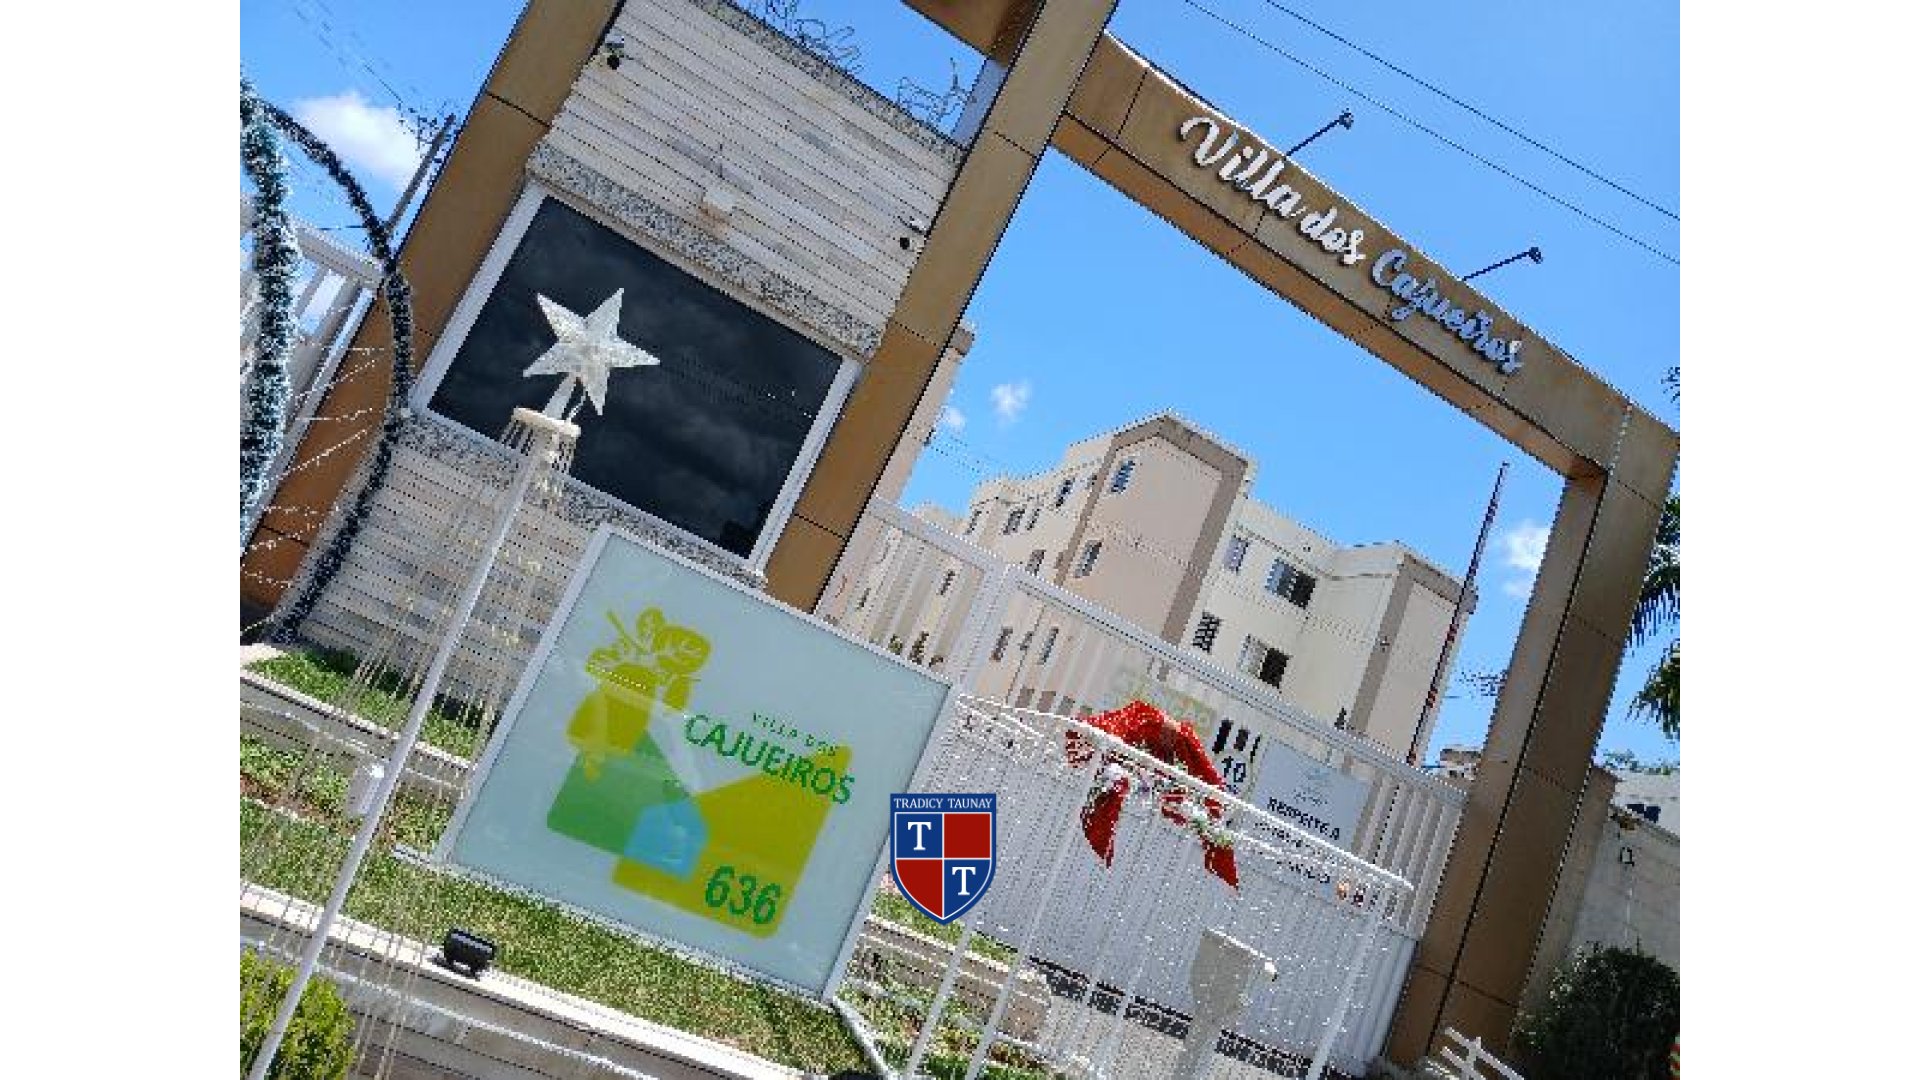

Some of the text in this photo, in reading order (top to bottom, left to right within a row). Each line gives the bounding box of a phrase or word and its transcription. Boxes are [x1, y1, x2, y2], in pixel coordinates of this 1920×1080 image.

[1178, 115, 1524, 375] Villa dos Cajueiros
[684, 713, 856, 805] CAJUEIROS
[753, 712, 799, 738] VILLA
[705, 864, 782, 925] 636
